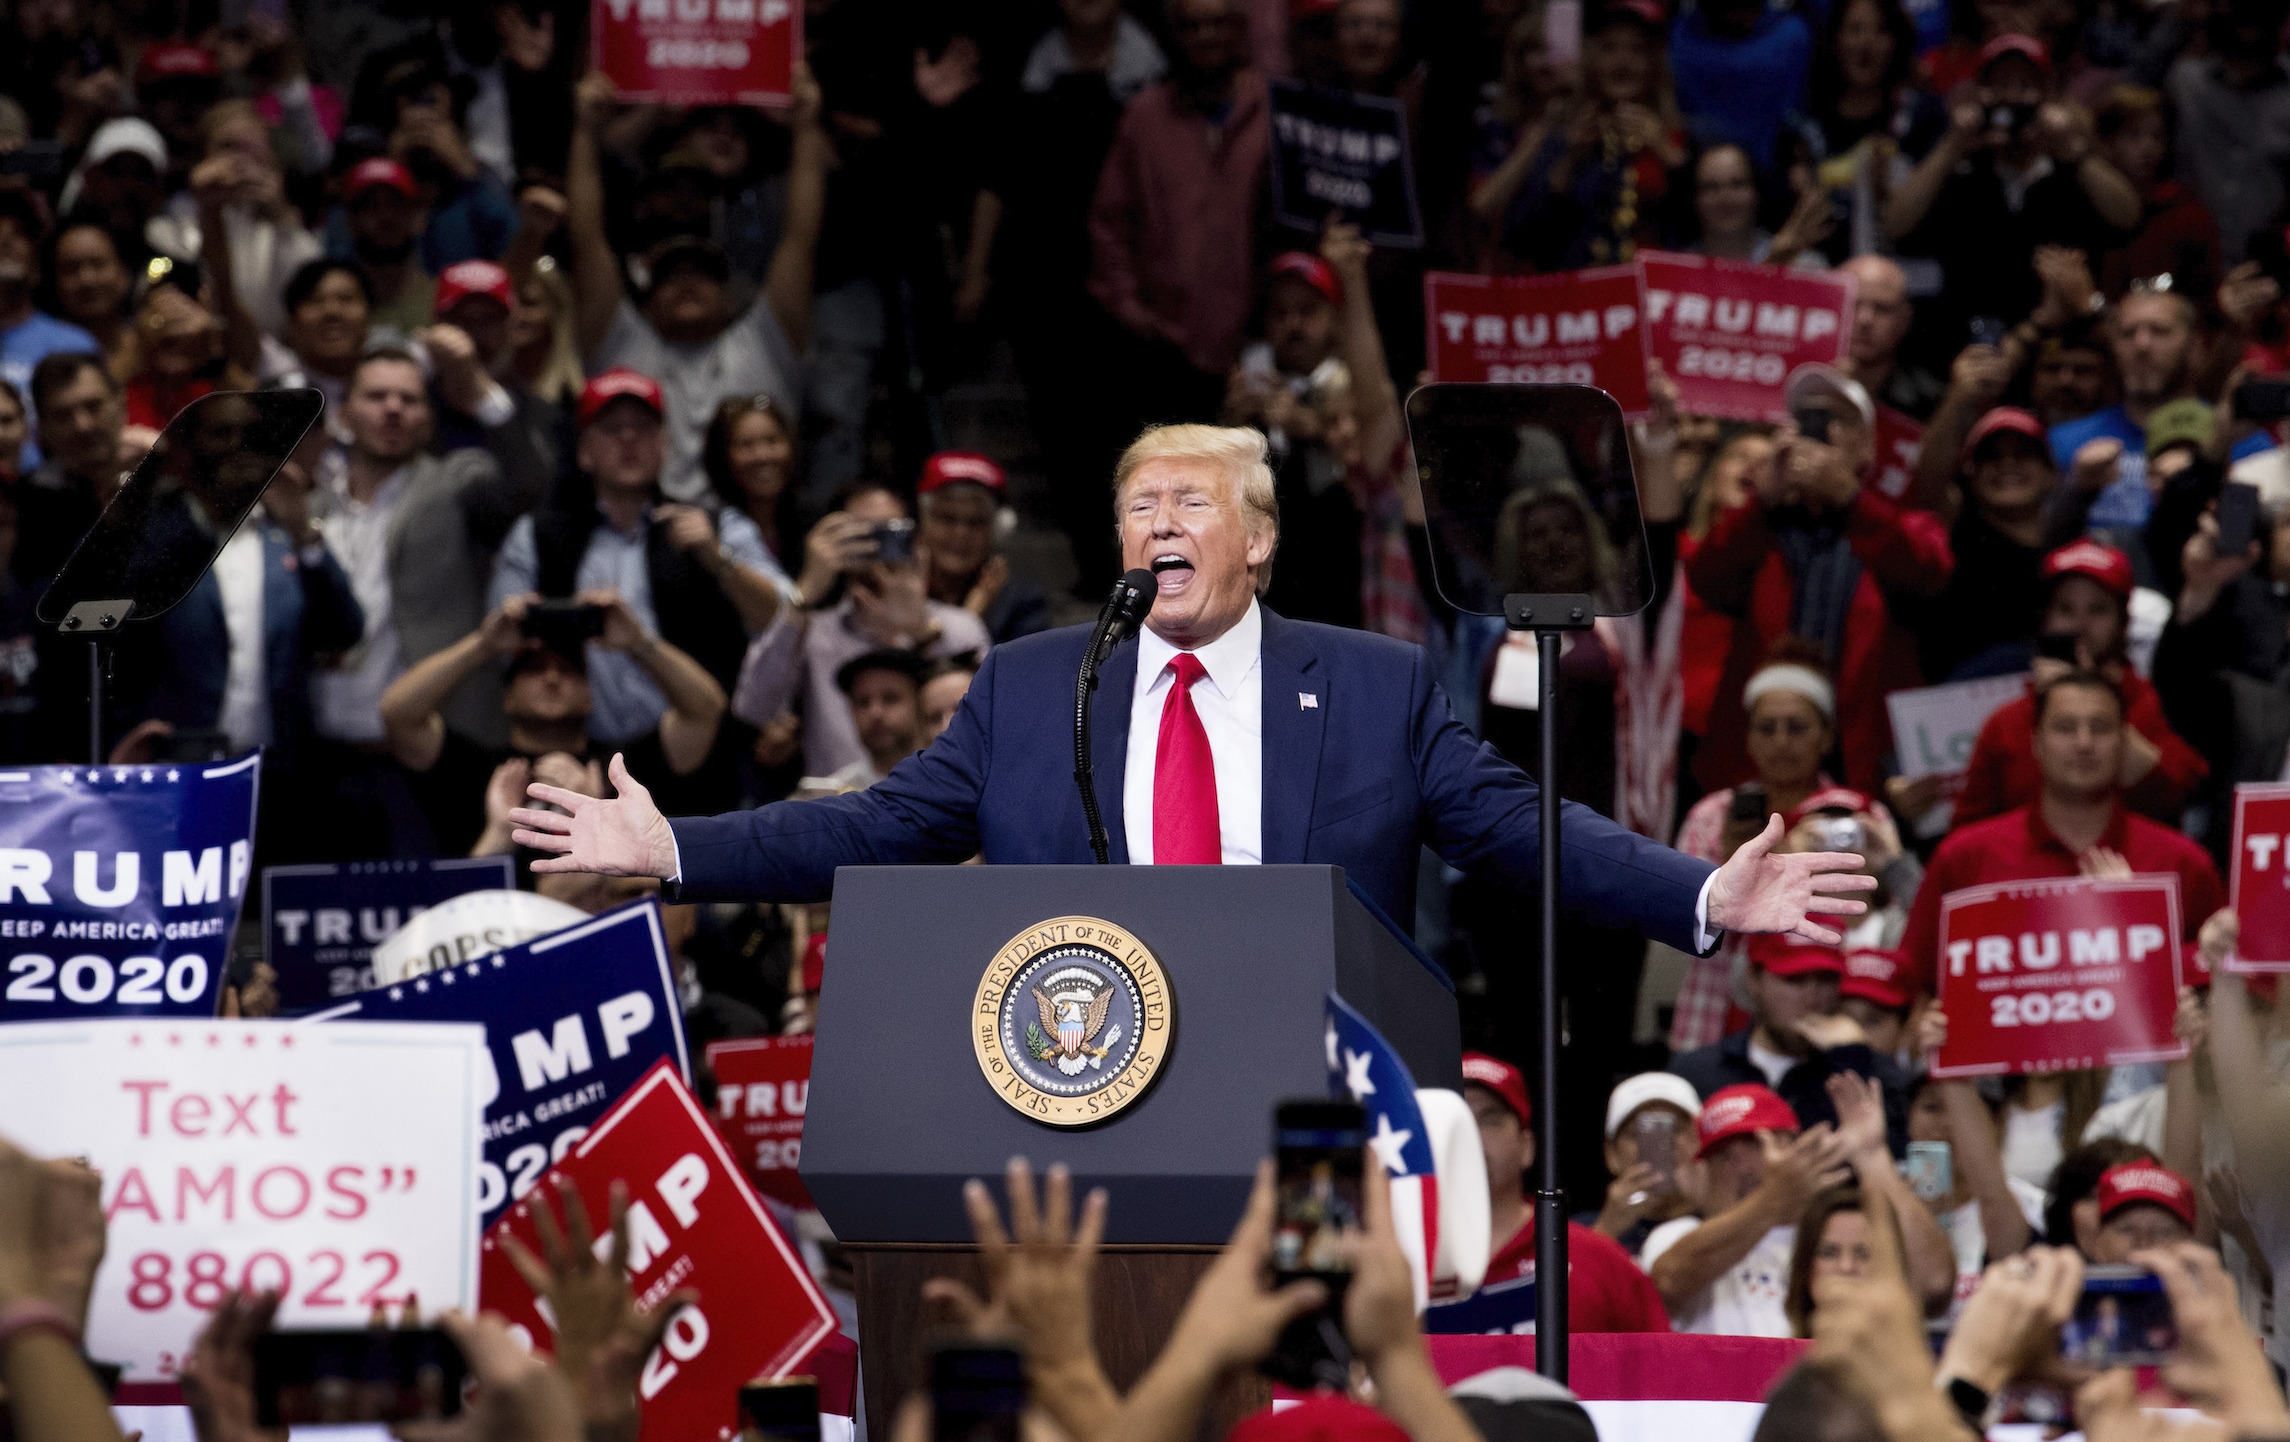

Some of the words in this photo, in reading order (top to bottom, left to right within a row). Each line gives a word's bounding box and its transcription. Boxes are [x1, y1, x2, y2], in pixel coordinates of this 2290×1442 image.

[1276, 112, 1400, 167] TRUMP
[1440, 304, 1637, 347] TRUMP
[1646, 288, 1840, 342] TRUMP
[1677, 345, 1787, 385] 2020
[52, 921, 158, 940] AMERICA
[1075, 926, 1094, 939] OF
[1098, 930, 1122, 950] THE
[1948, 924, 2165, 977] TRUMP
[6, 952, 208, 1005] 2020
[980, 924, 1070, 1016] PRESIDENT
[1125, 947, 1164, 1031] UNITED
[1991, 988, 2117, 1028] 2020
[983, 1024, 995, 1053] THE
[989, 1056, 1004, 1074] OF
[1087, 1050, 1155, 1115] STATES
[121, 1080, 299, 1138] Text
[534, 1080, 607, 1122] GREAT!
[1003, 1072, 1052, 1115] SEAL
[127, 1251, 403, 1312] 88022
